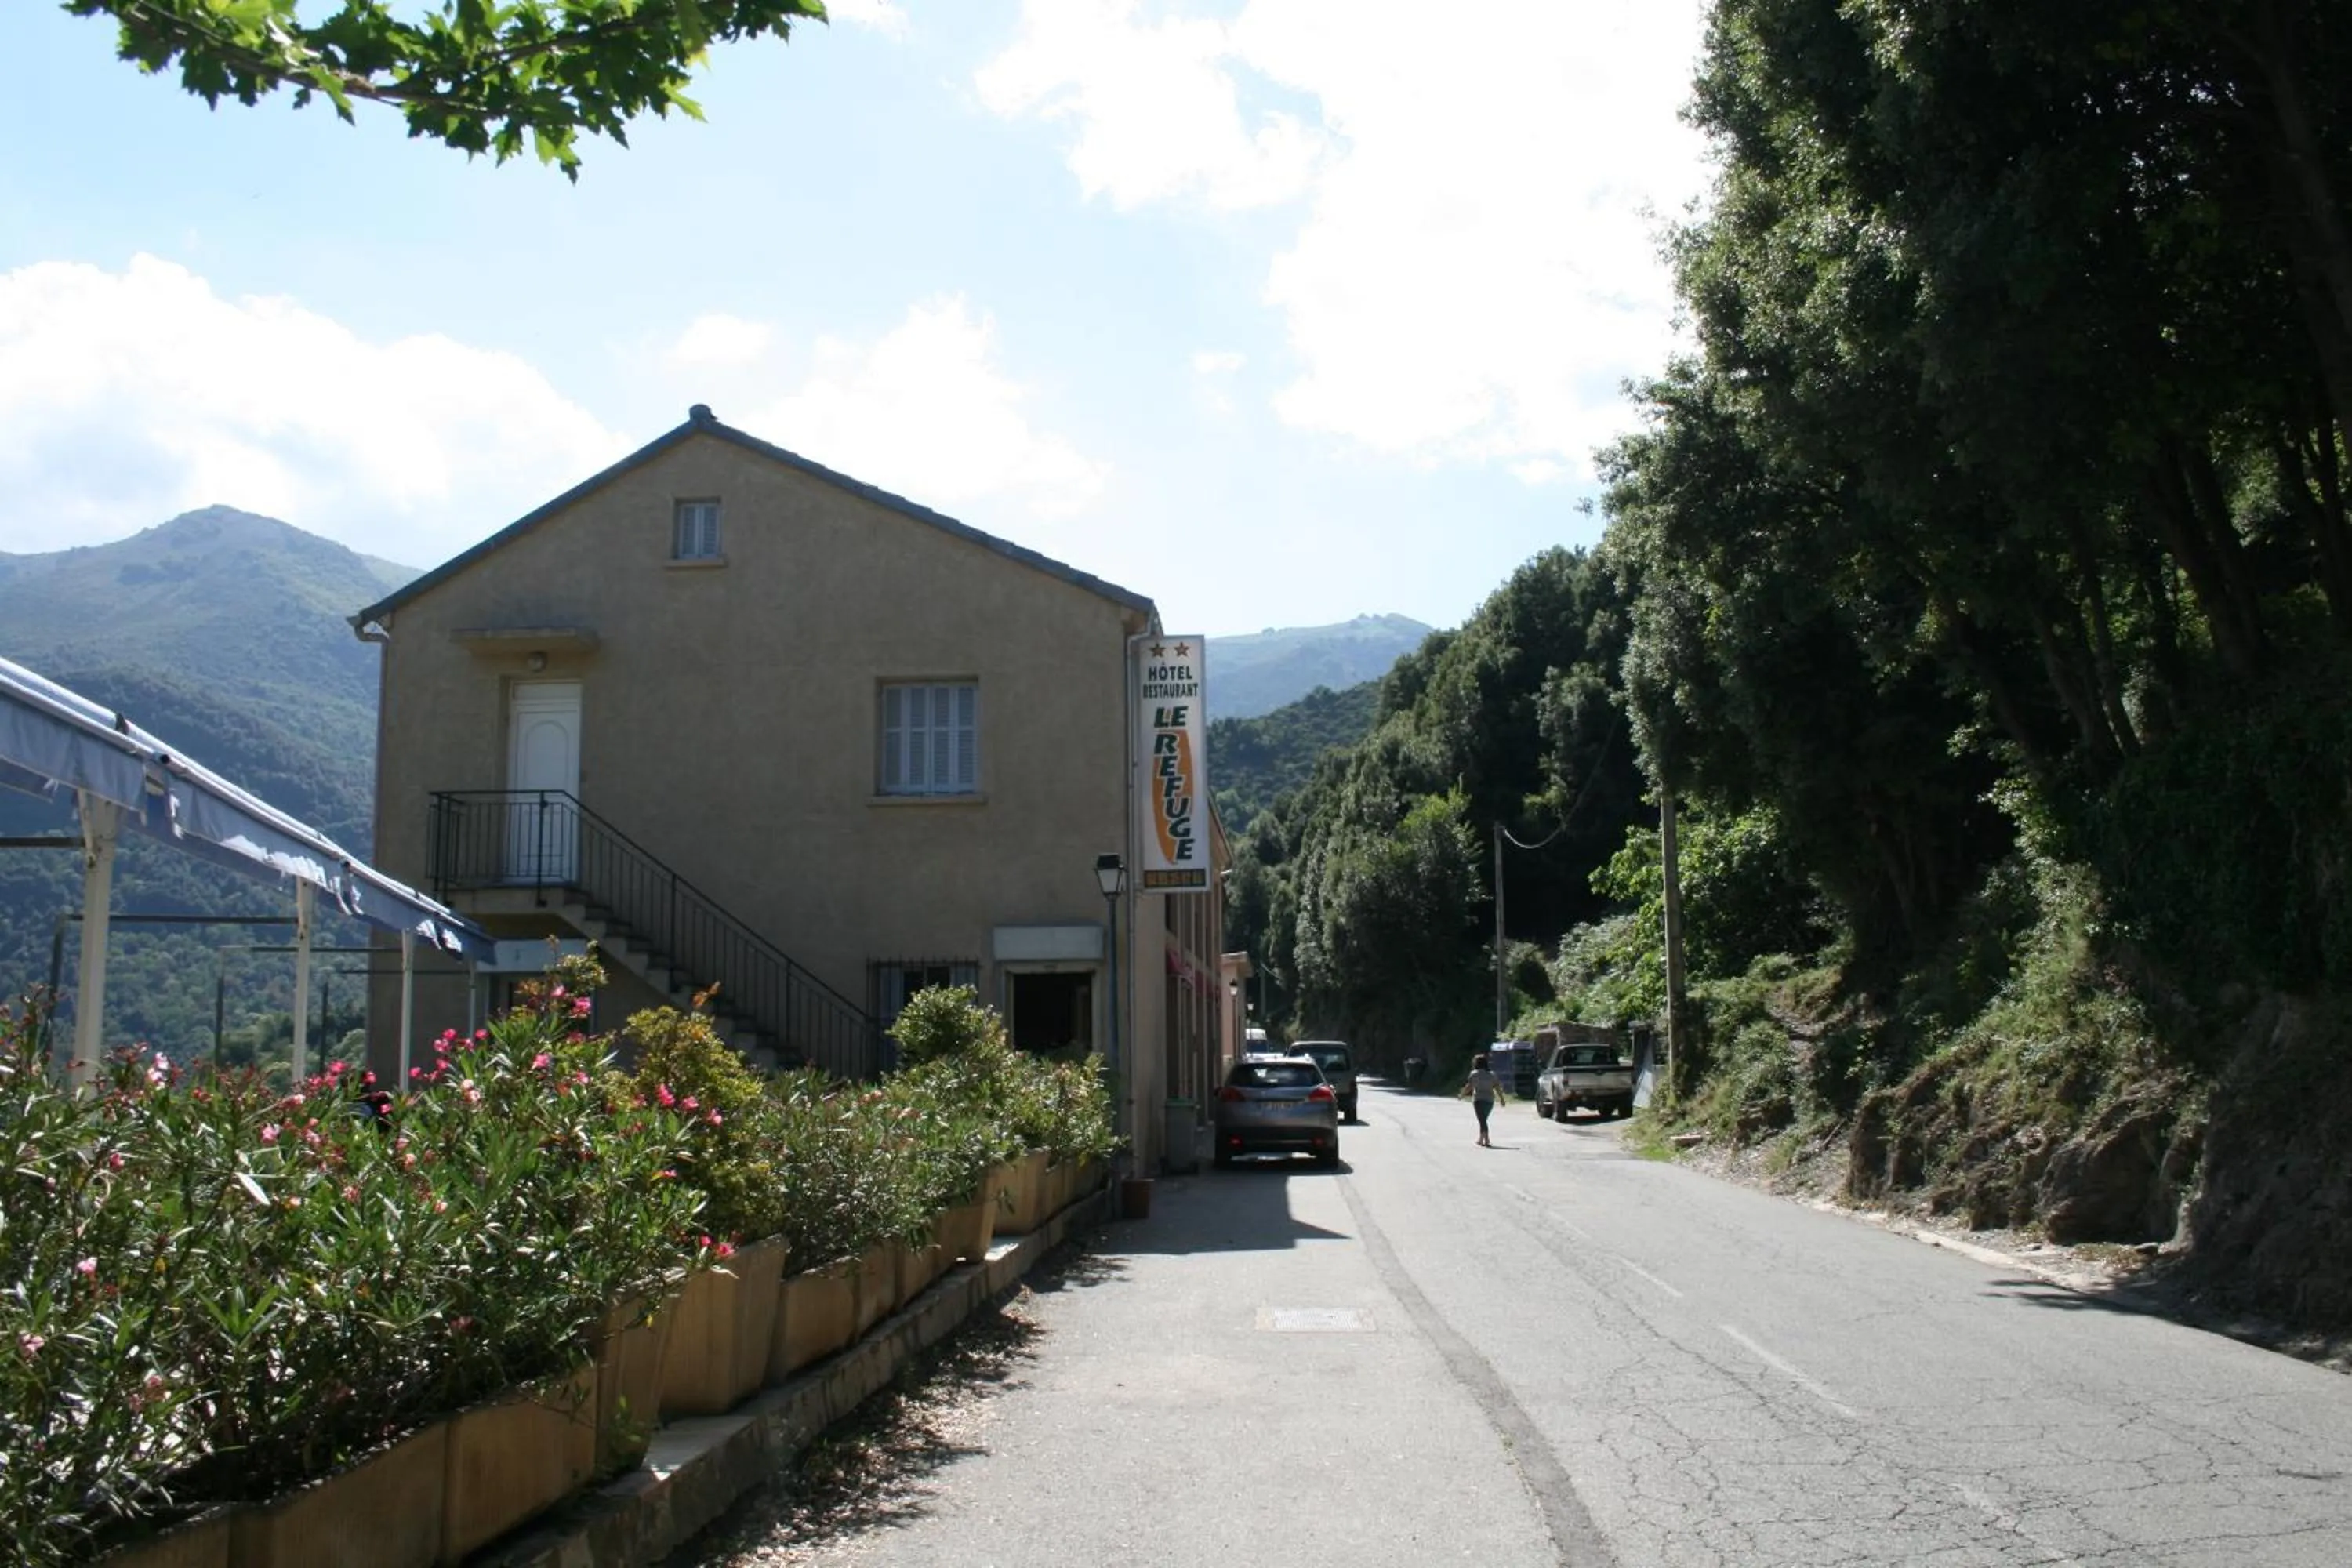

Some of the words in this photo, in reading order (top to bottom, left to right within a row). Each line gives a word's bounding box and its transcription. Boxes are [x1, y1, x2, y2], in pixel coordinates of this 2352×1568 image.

[1142, 682, 1199, 699] RESTAURANT
[1154, 706, 1189, 728] LE
[1154, 733, 1196, 860] REFUGE
